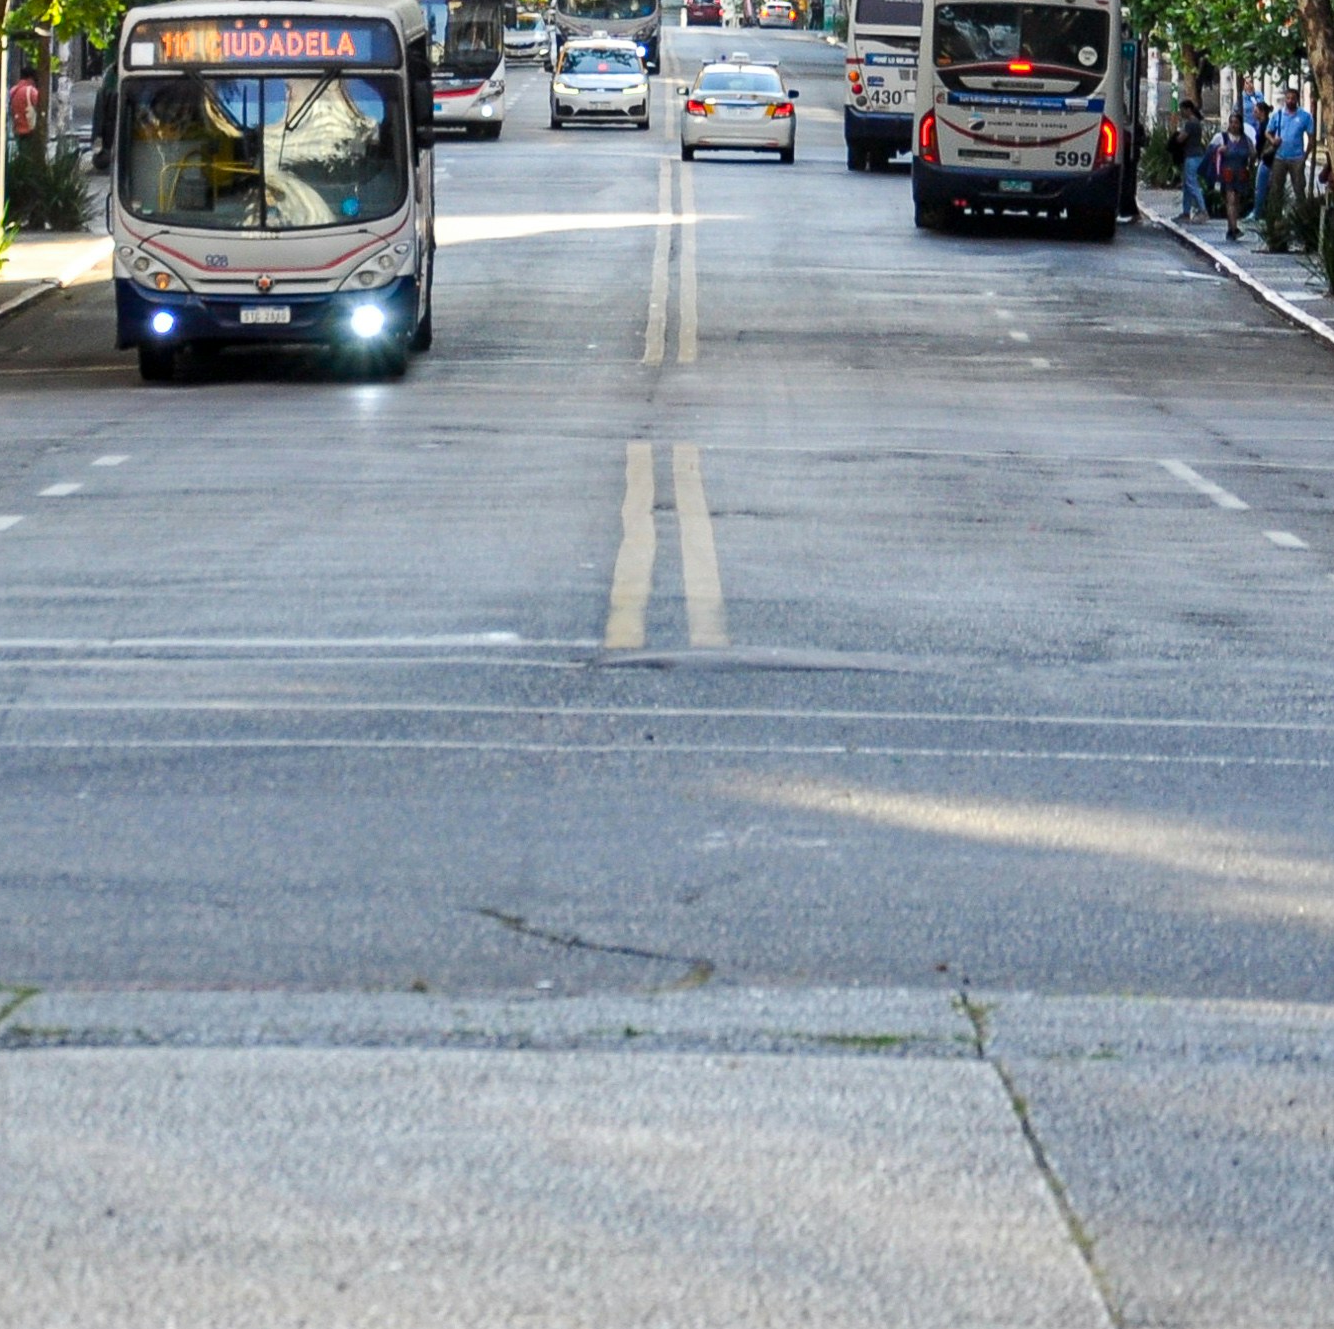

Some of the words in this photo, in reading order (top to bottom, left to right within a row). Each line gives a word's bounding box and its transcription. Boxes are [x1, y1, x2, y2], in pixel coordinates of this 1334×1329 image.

[161, 31, 196, 57] 110
[207, 31, 356, 57] CIUDADELA
[871, 90, 902, 105] 430
[1055, 151, 1092, 167] 599
